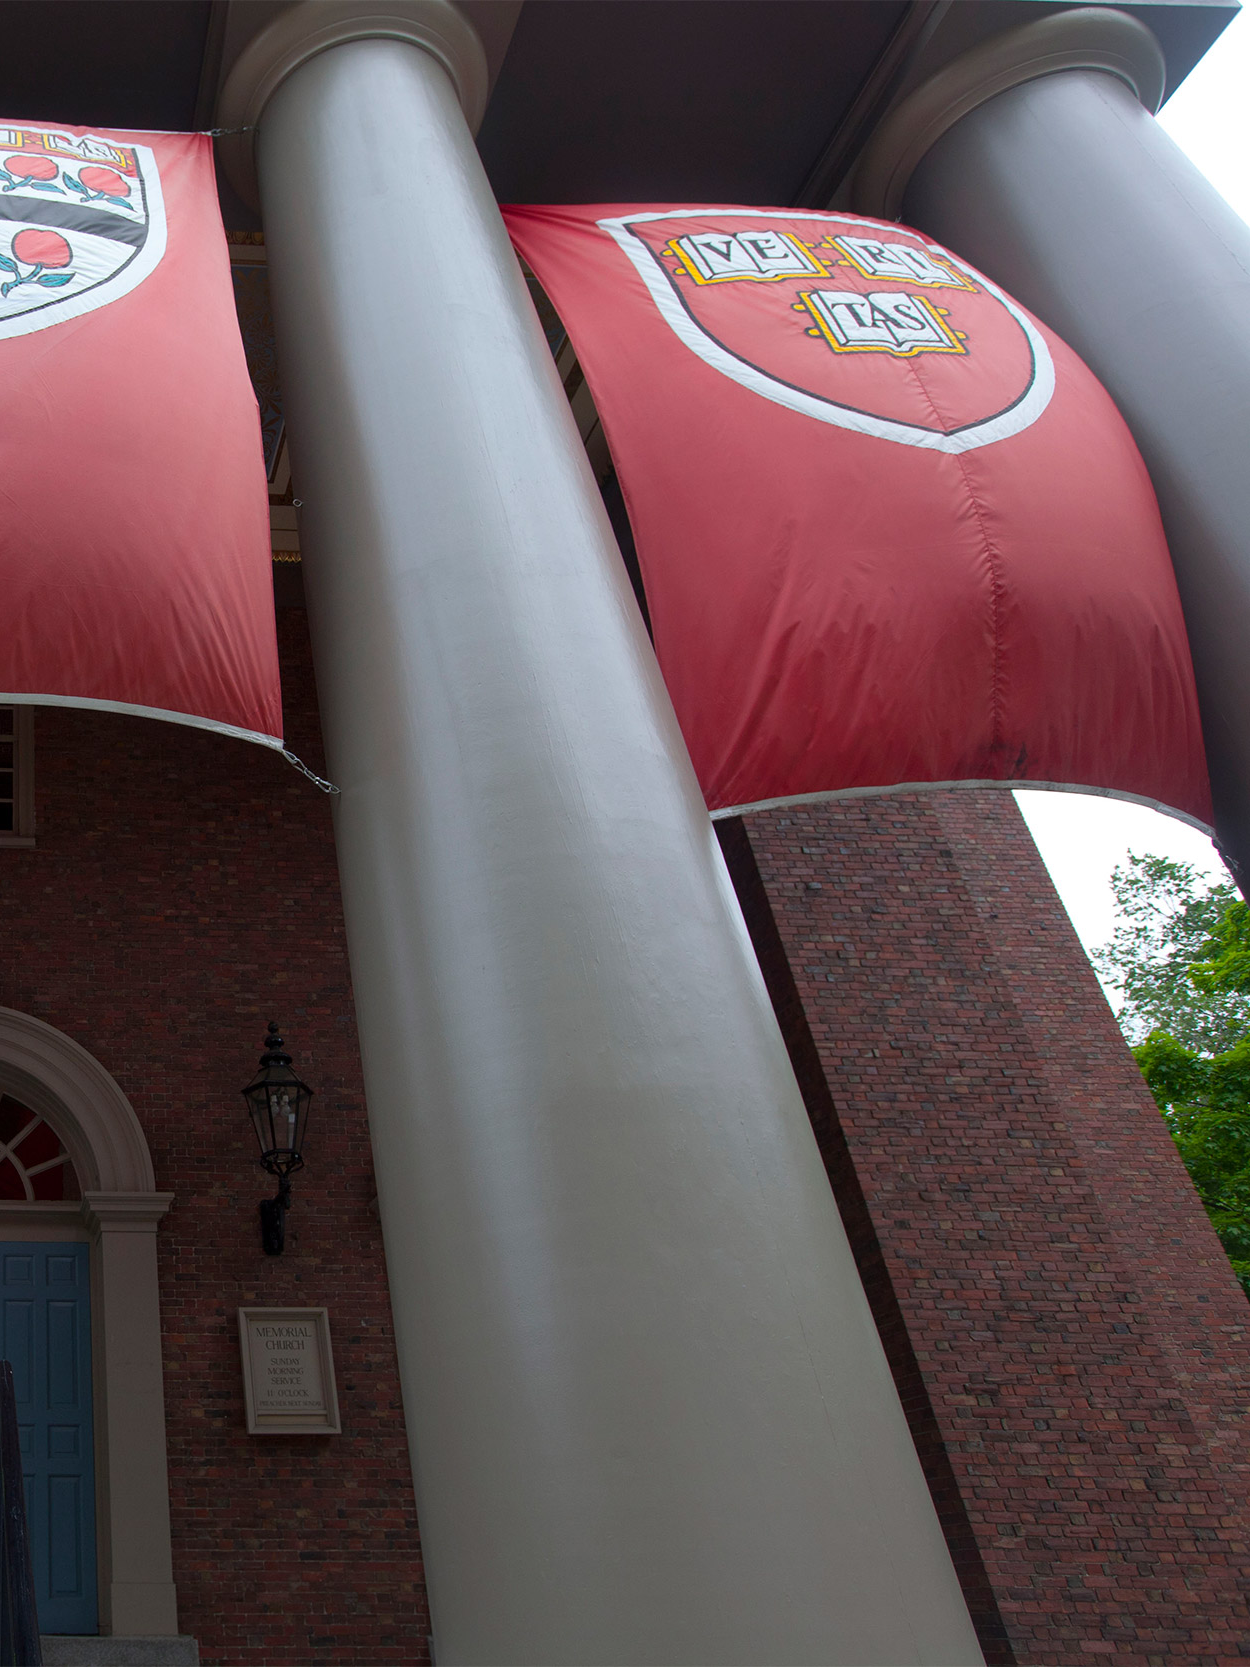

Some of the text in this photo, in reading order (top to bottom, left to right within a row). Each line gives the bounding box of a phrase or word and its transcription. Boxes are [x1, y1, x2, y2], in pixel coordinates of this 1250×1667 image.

[697, 239, 931, 274] VE RI
[831, 302, 926, 330] TAS
[256, 1327, 312, 1337] MEMORIAL
[265, 1340, 305, 1350] CHURCH
[270, 1357, 300, 1366] SUNDAY
[267, 1367, 304, 1376] MORNING
[271, 1376, 302, 1385] SERVICE
